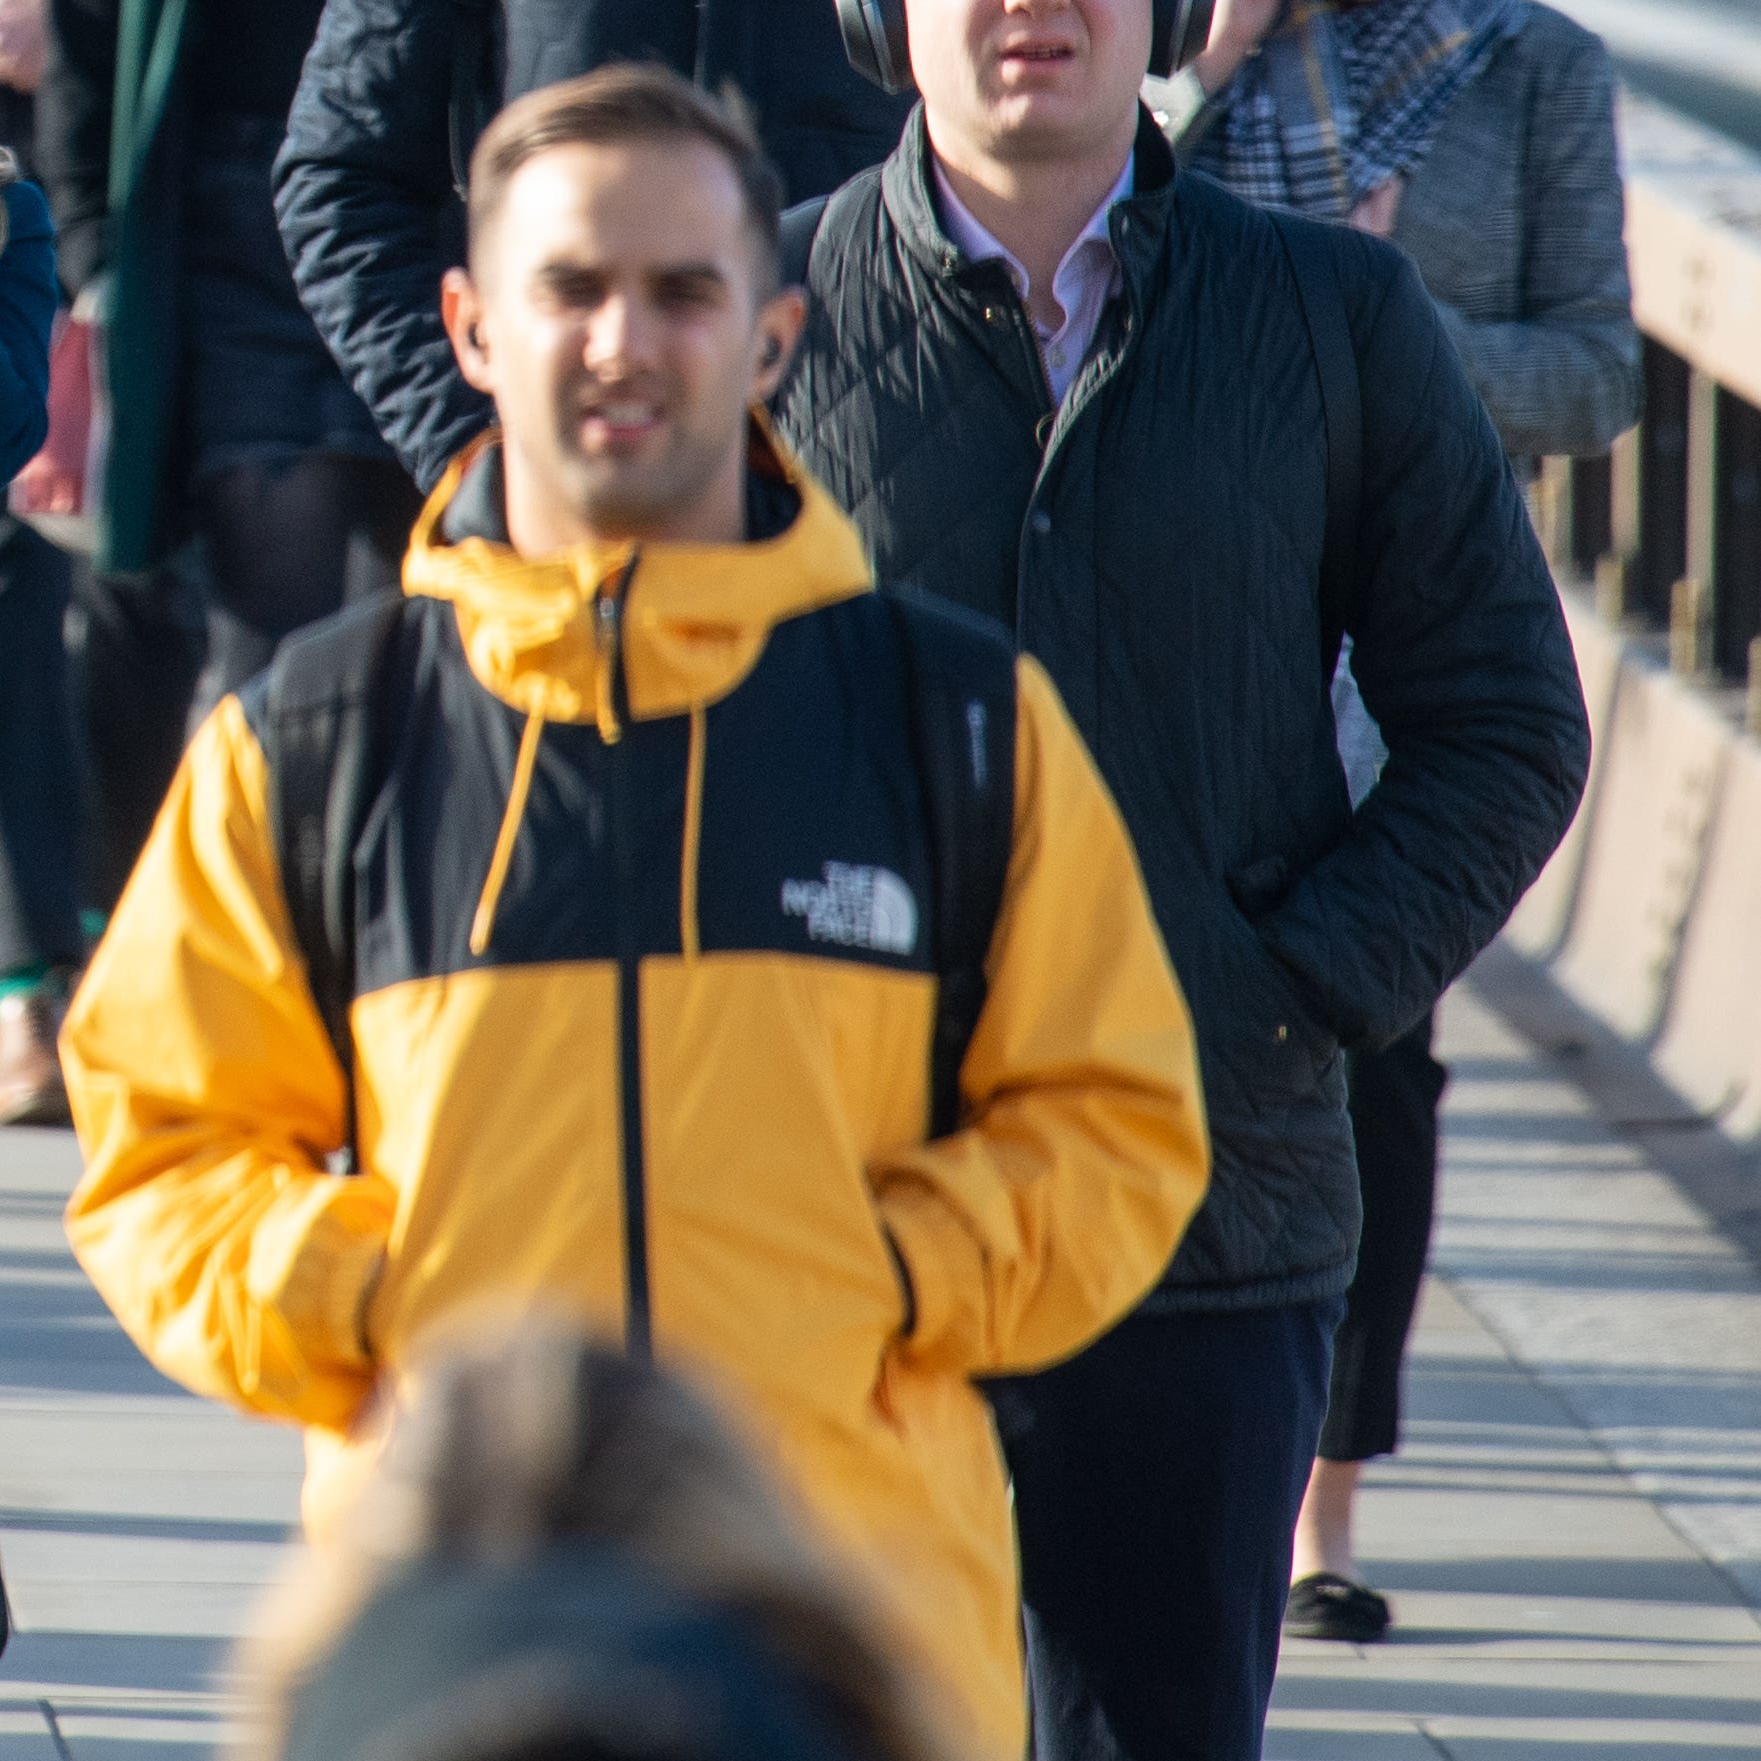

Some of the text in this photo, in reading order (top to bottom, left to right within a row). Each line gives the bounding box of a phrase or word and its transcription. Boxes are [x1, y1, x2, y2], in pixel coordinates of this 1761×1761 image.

[823, 860, 874, 893] THE
[781, 878, 874, 922] NORTH
[807, 913, 874, 948] FACE
